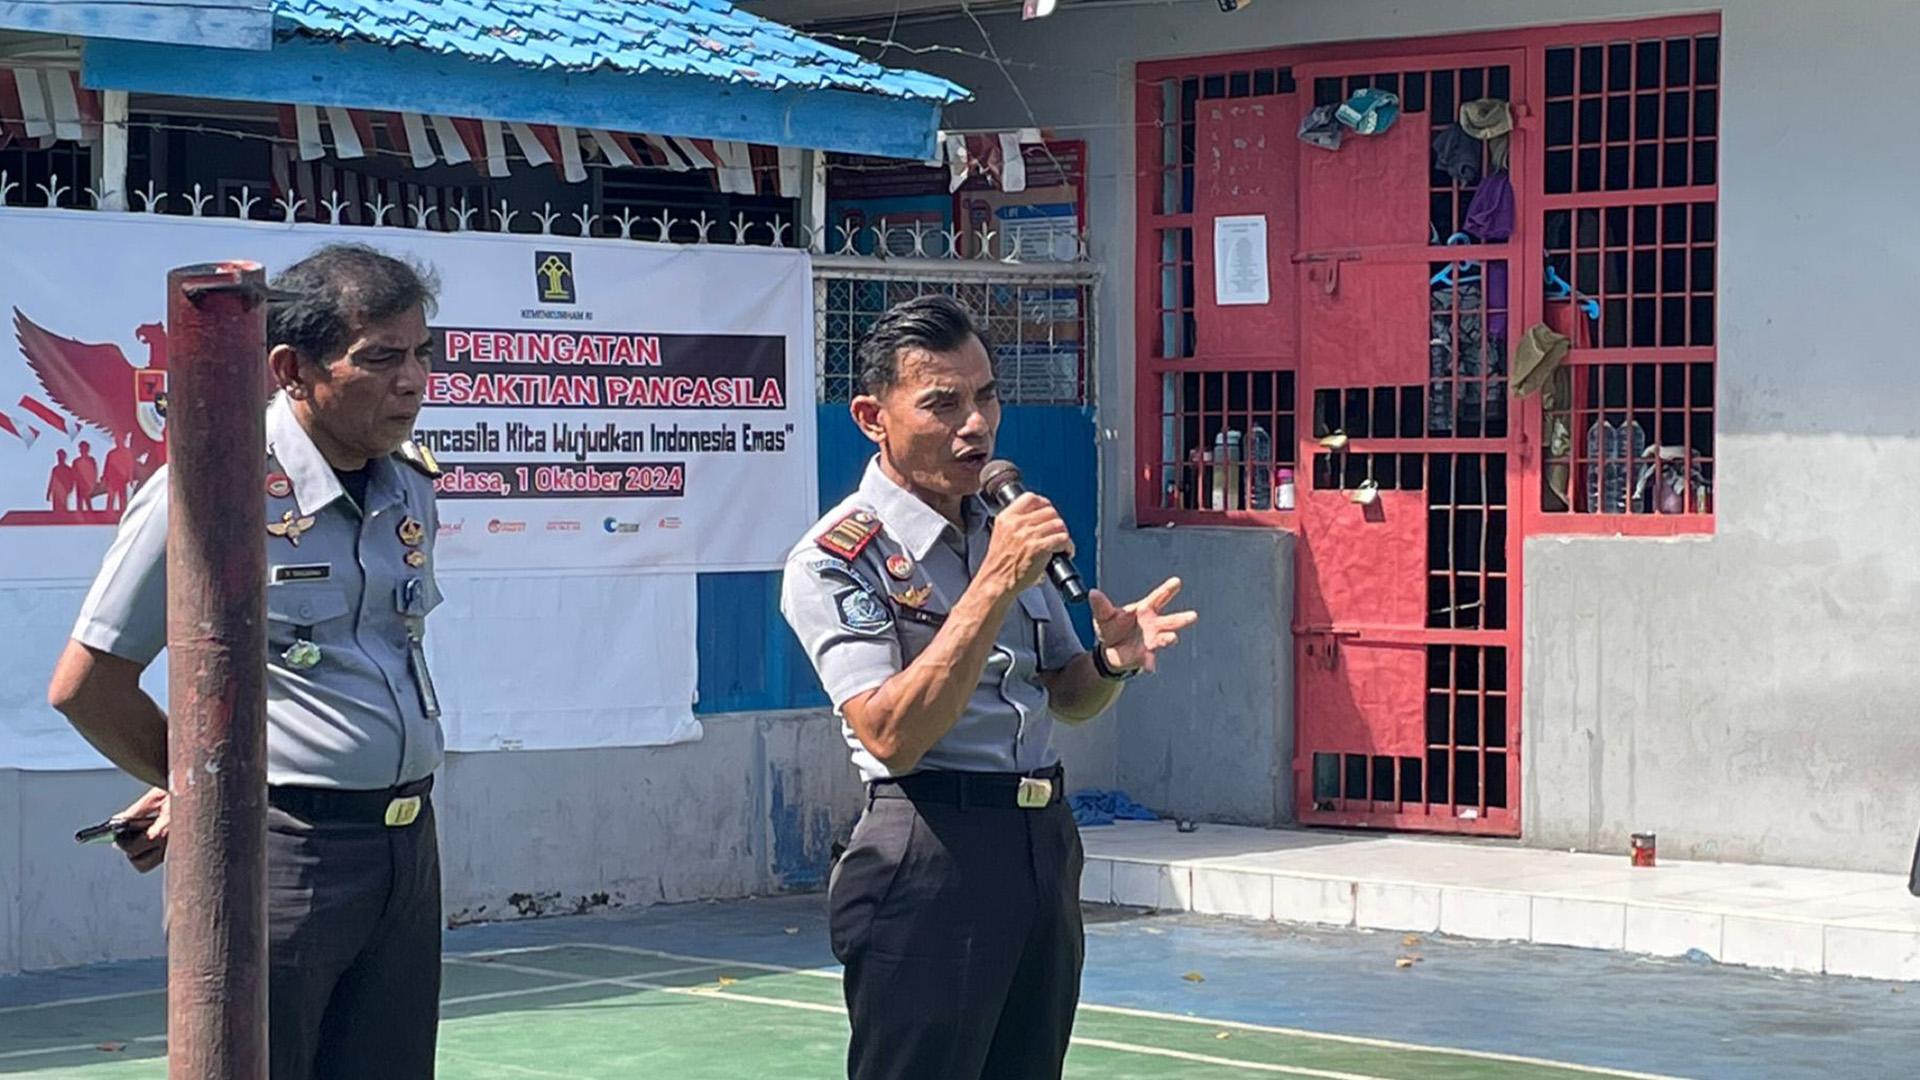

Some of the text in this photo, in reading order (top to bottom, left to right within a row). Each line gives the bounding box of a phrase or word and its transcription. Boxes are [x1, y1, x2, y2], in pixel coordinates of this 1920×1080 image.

[445, 331, 662, 366] PERINGATAN
[424, 373, 785, 407] ESAKTIAN PANCASILA
[414, 422, 795, 461] ancasila Kita Wujudkan Indonesia Emas"
[516, 467, 529, 492] 1
[535, 465, 623, 492] Oktober
[625, 466, 683, 492] 2024
